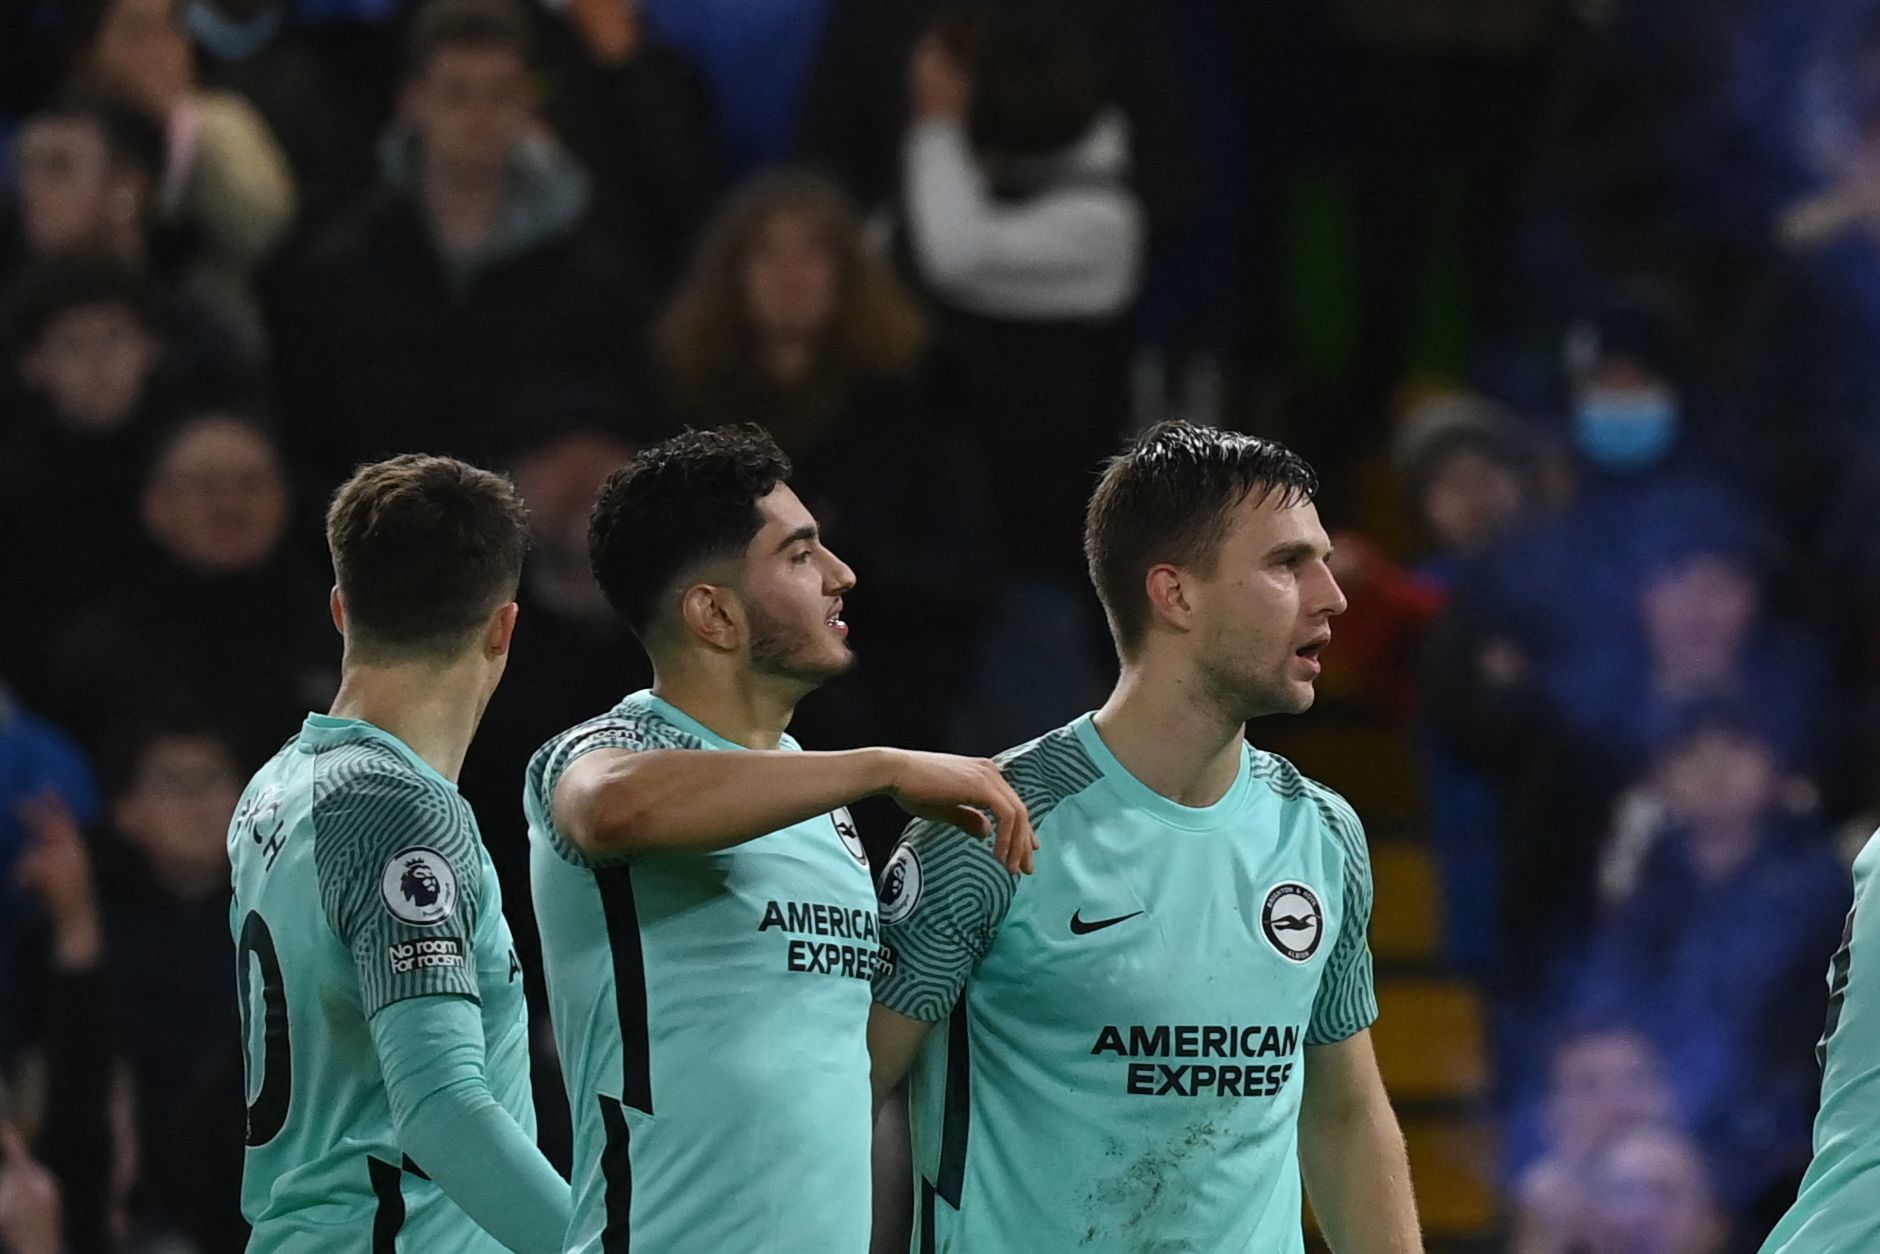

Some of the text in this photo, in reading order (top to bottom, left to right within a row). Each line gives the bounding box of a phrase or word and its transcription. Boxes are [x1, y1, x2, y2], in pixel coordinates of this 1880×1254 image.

[758, 900, 879, 944] AMERICA
[388, 940, 458, 959] No room
[391, 957, 415, 975] for
[1091, 1025, 1300, 1058] AMERICAN
